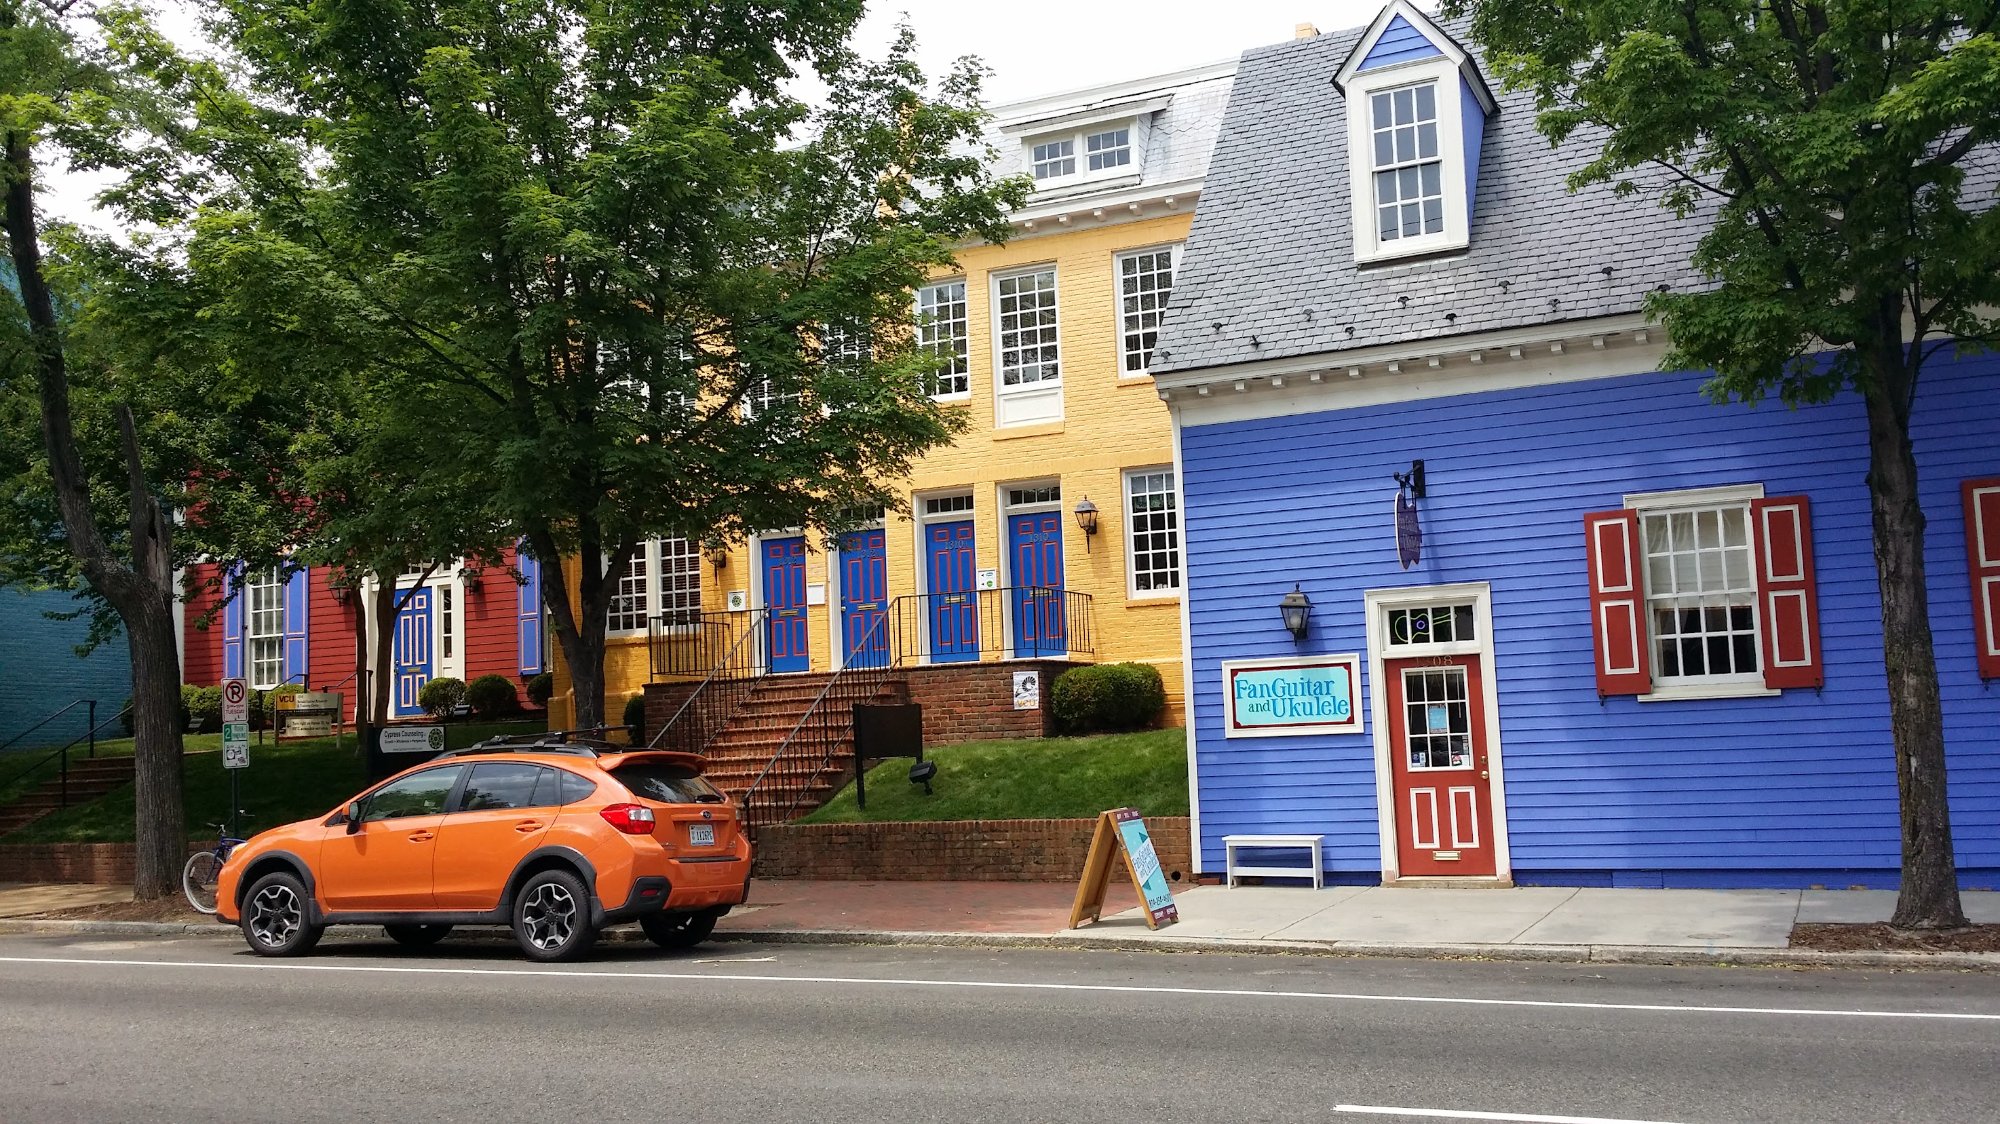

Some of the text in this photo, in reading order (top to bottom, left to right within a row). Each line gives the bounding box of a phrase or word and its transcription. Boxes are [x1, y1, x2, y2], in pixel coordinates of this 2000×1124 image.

[1248, 696, 1349, 717] and Ukulele
[225, 727, 231, 739] 2
[402, 730, 424, 738] Counseling
